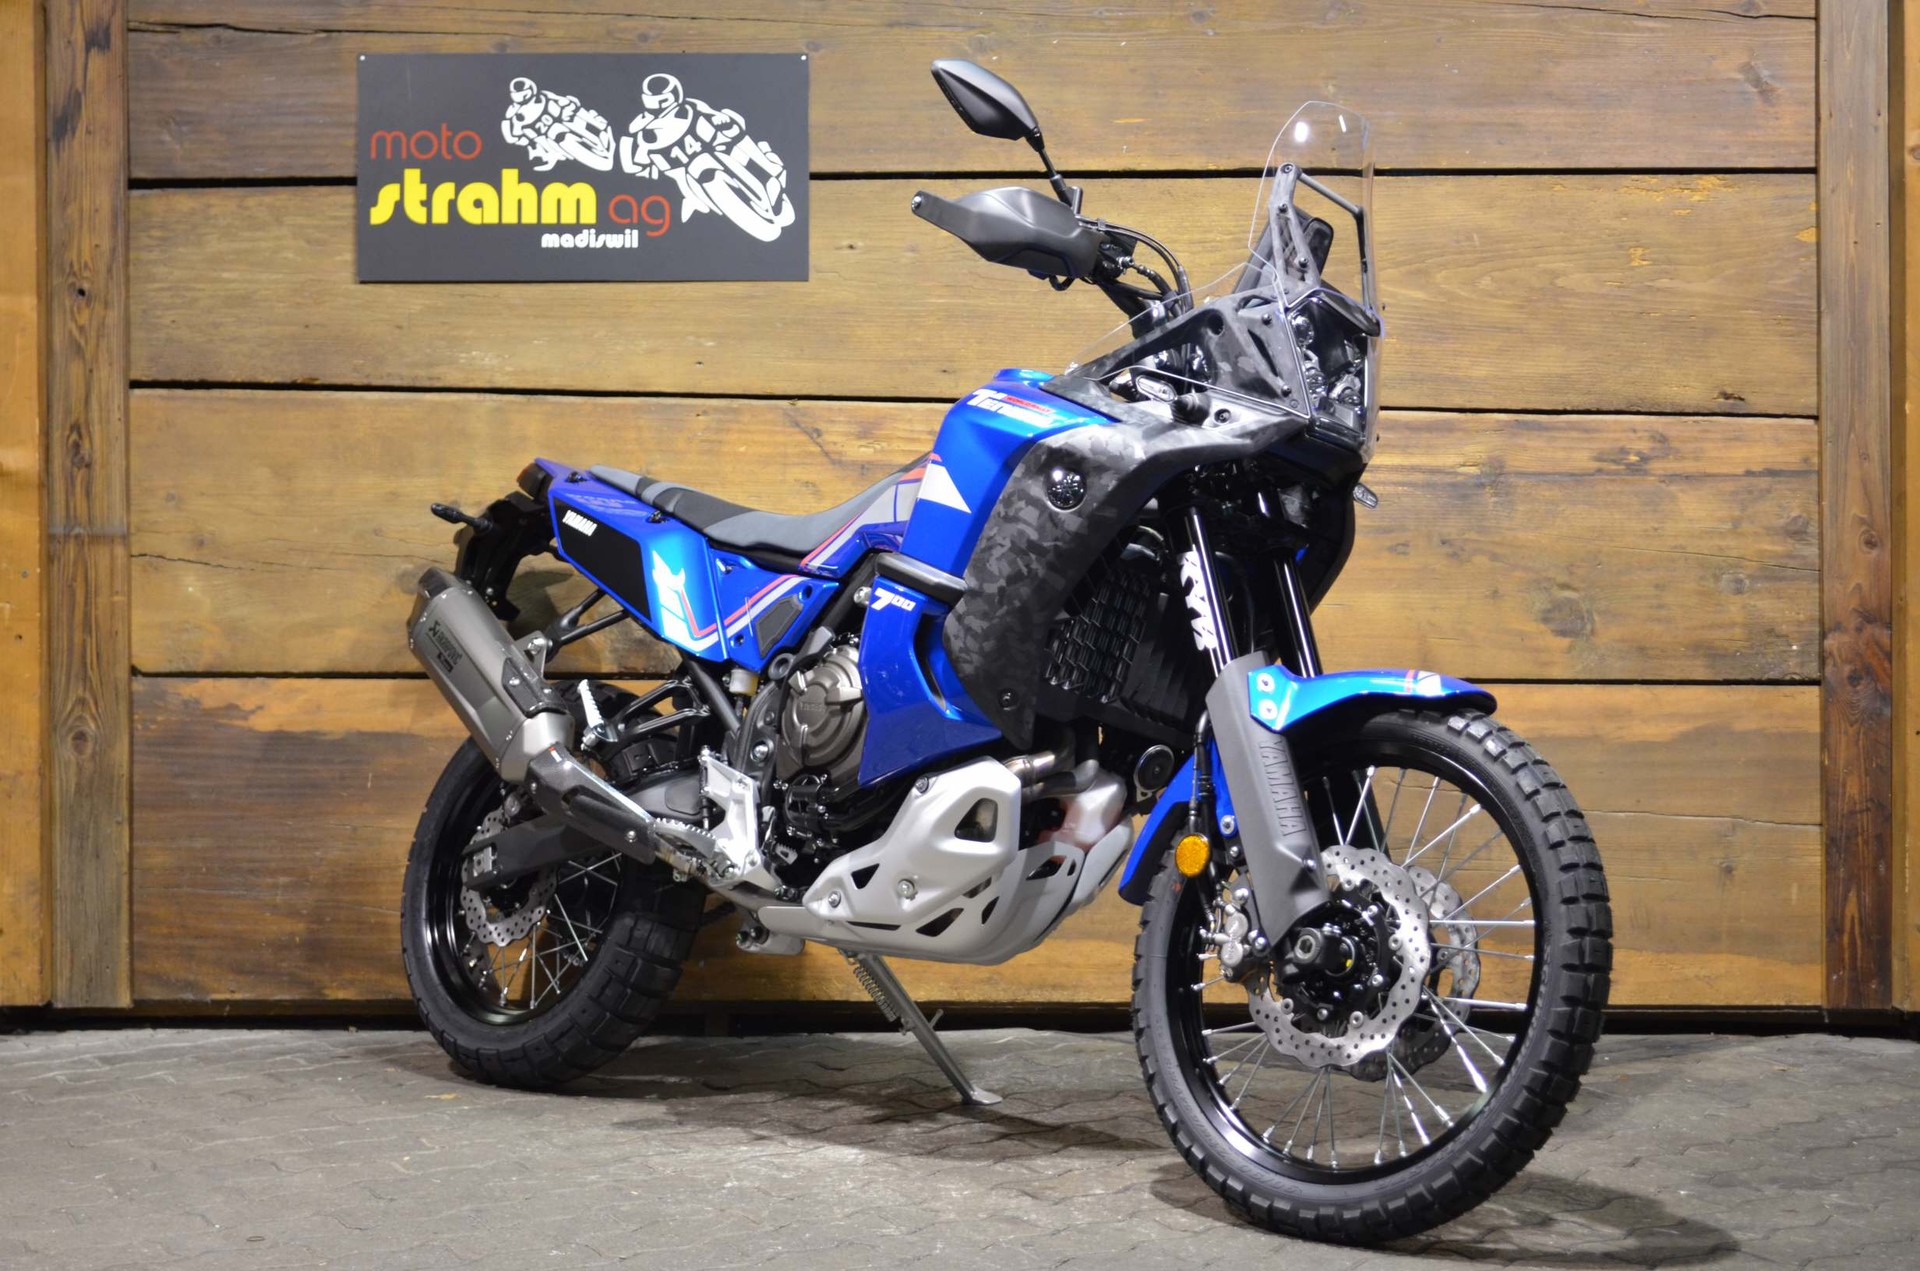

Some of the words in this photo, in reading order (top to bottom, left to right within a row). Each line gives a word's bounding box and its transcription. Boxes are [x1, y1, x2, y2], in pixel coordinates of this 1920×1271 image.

[535, 113, 554, 135] 20
[370, 123, 482, 160] moto
[669, 138, 703, 165] 14
[369, 167, 597, 225] strahm
[607, 194, 671, 237] ag
[540, 228, 639, 249] madiswil
[871, 587, 917, 612] 700
[1259, 739, 1308, 838] YAMAHA
